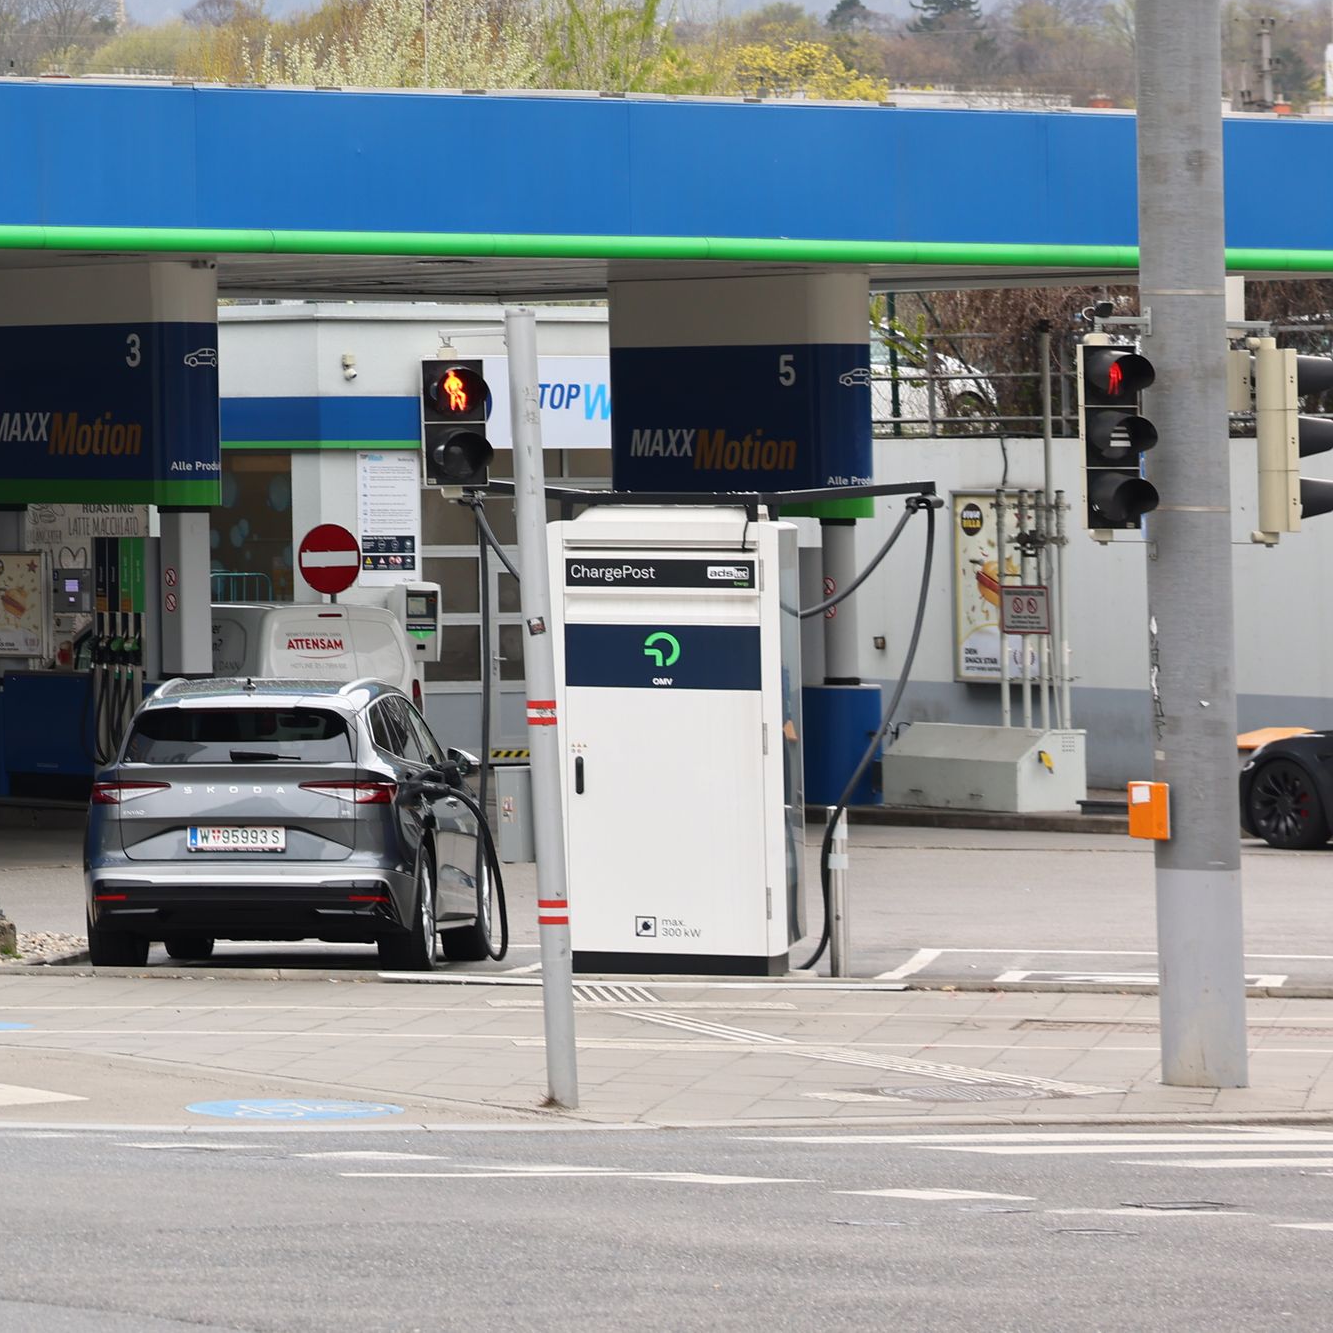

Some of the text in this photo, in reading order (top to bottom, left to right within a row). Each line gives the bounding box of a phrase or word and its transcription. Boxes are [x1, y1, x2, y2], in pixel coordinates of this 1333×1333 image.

[125, 333, 141, 367] 3
[779, 354, 796, 387] 5
[171, 462, 192, 472] Alle
[827, 476, 849, 486] Alle
[68, 516, 90, 536] LATTE
[570, 564, 656, 582] ChargePost
[287, 638, 344, 650] ATTENSAM
[652, 677, 673, 686] OMV
[199, 829, 210, 844] W
[661, 927, 702, 938] 300 kW
